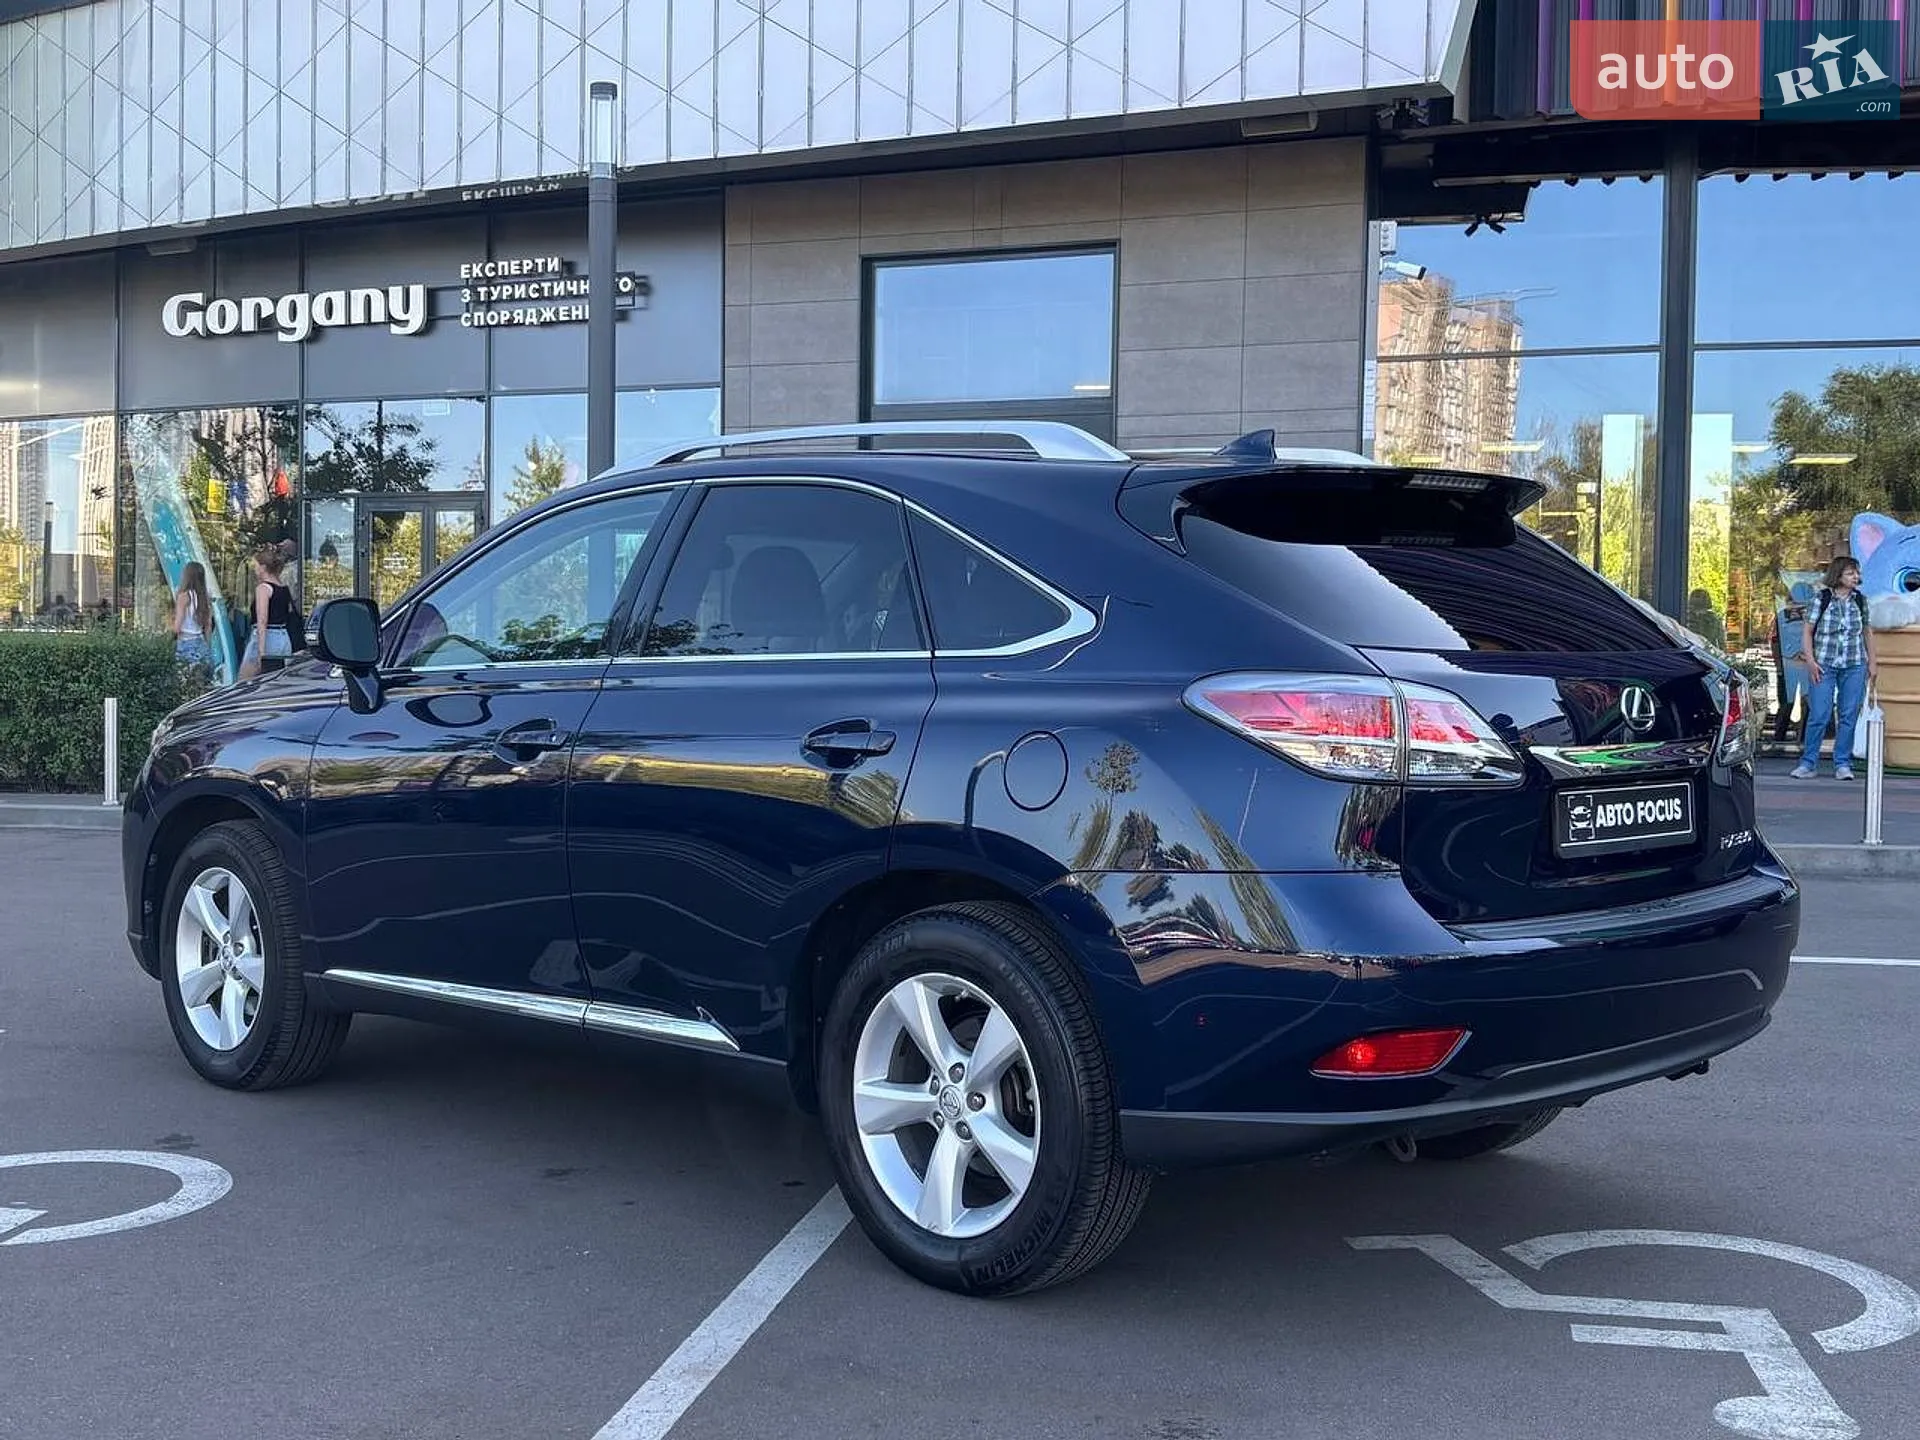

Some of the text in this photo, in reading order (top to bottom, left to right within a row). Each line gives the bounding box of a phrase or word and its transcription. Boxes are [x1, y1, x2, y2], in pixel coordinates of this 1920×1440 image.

[460, 257, 560, 279] ЕКСПЕРТИ
[477, 276, 632, 302] ТУРИСТИЧНО
[161, 284, 427, 343] Gorgany
[1595, 798, 1682, 828] АВТО FOCUS
